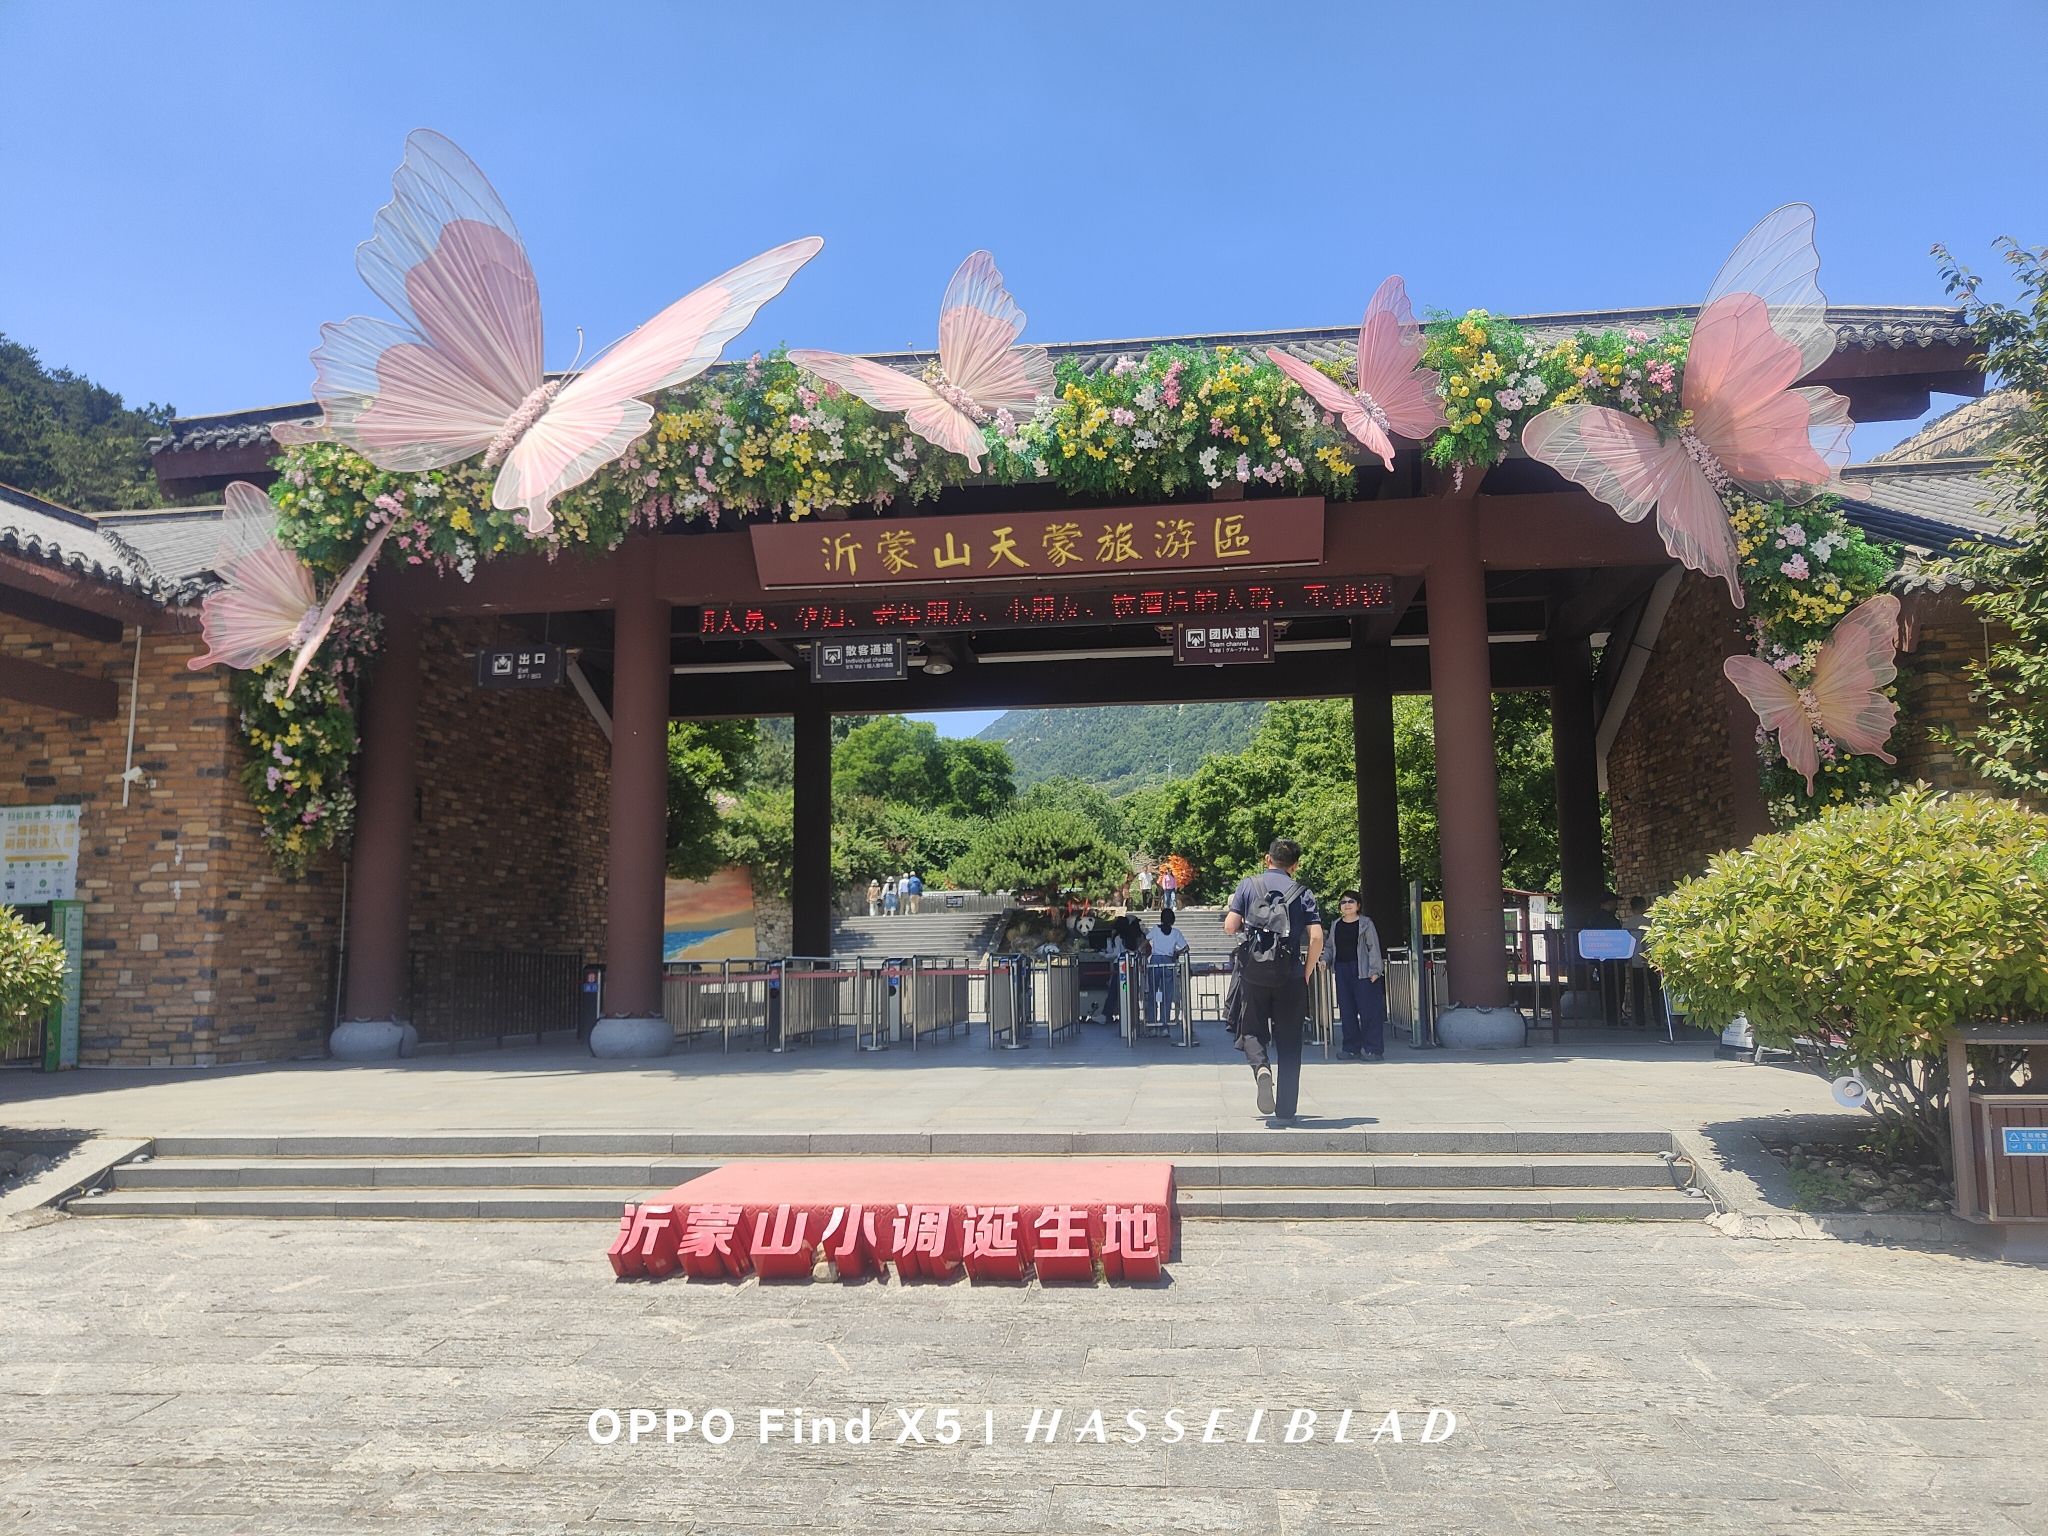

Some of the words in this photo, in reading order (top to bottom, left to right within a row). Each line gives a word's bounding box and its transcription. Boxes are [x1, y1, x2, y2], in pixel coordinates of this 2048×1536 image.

[822, 514, 1251, 575] 沂蒙山天蒙旅游區
[1208, 626, 1260, 641] 团队通道
[845, 643, 894, 656] 散客通道
[518, 653, 546, 665] 出口
[607, 1202, 1160, 1260] 沂蒙山小调诞生地
